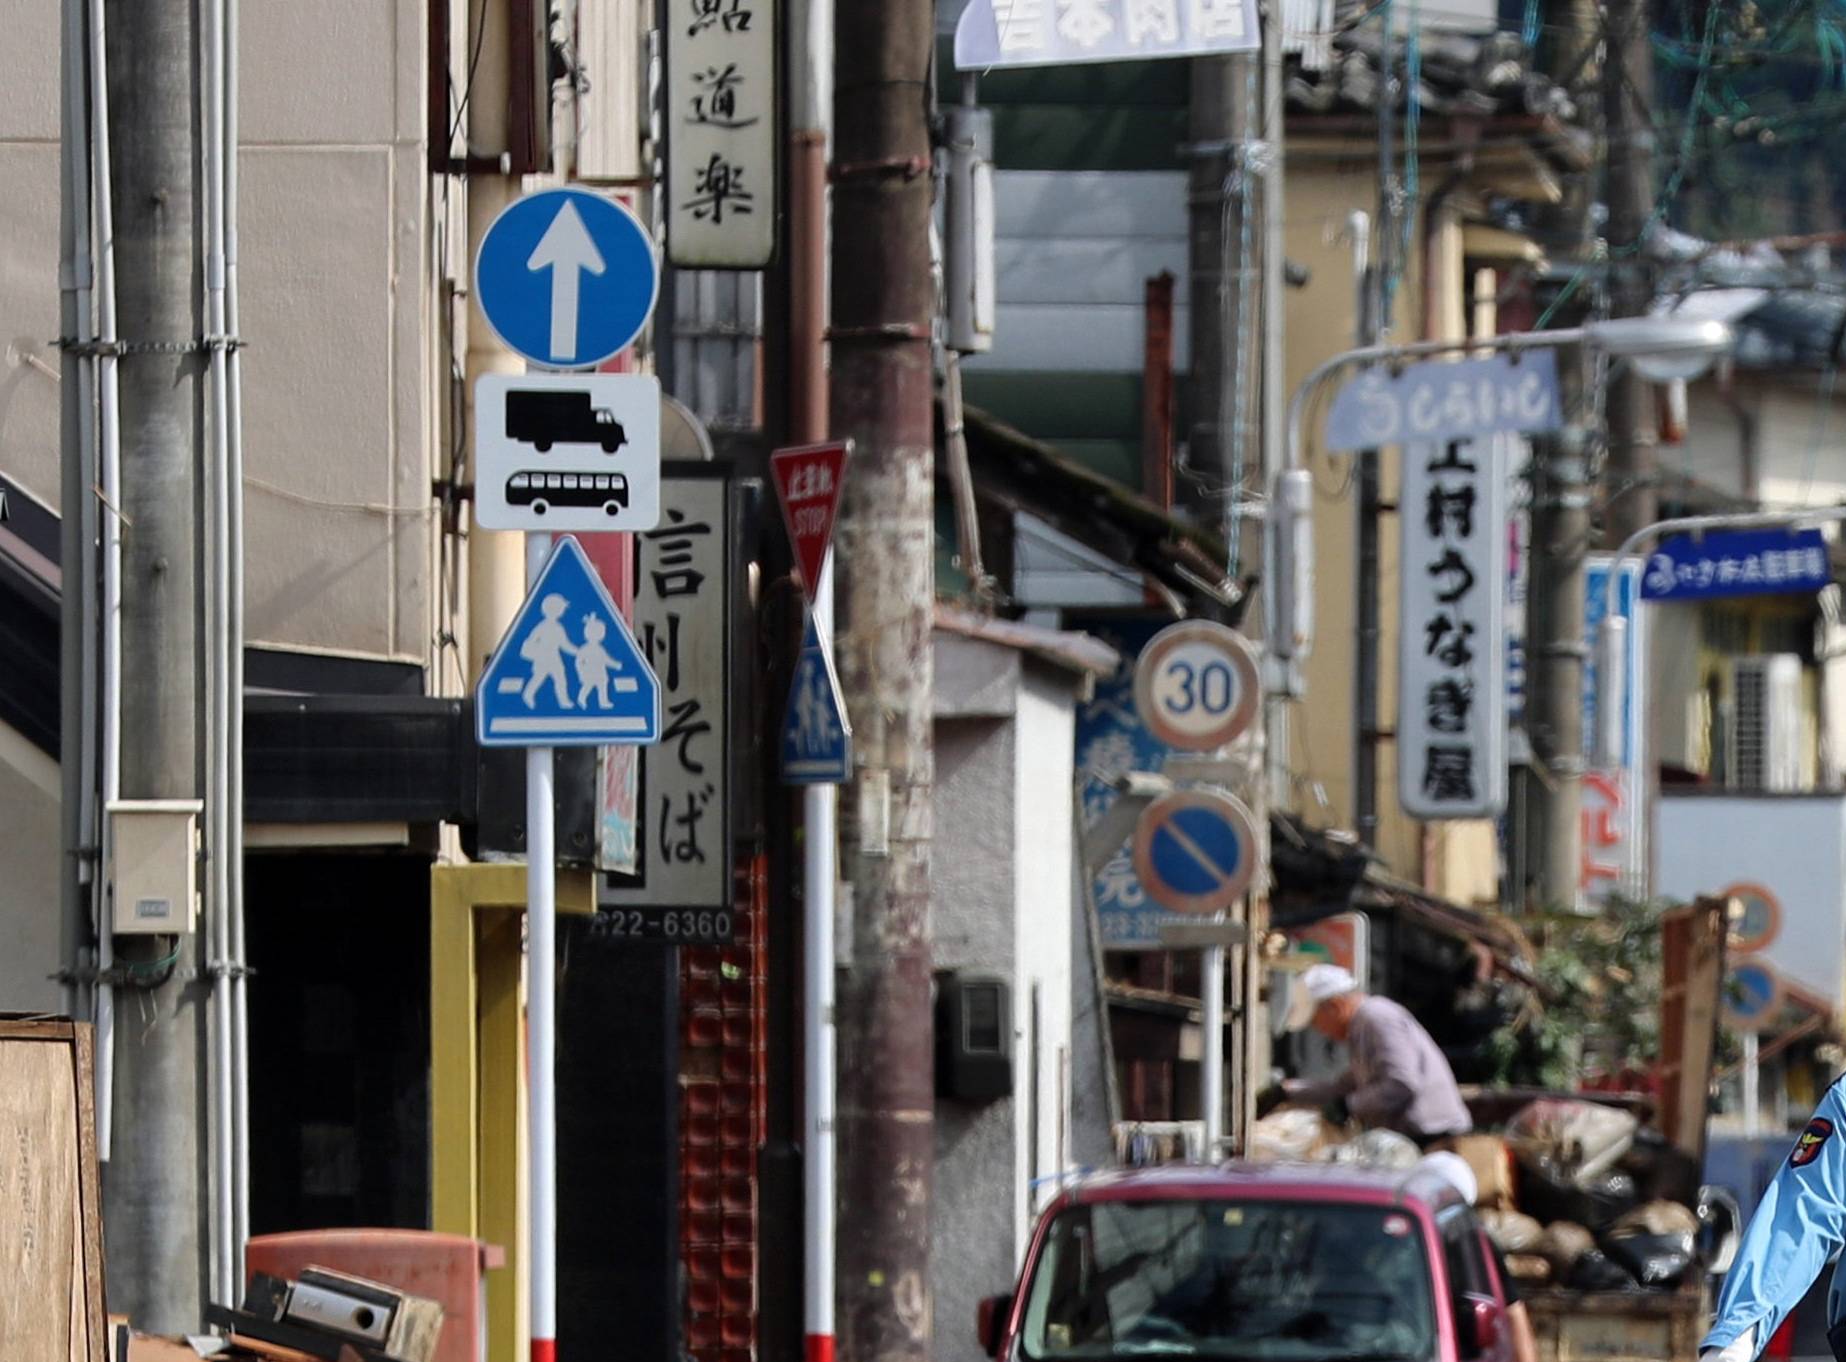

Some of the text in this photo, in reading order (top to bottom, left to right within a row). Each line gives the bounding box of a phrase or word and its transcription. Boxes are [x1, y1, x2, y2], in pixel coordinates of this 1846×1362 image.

[795, 505, 828, 536] STOP
[1165, 660, 1233, 715] 30
[611, 910, 731, 937] 22-6360
